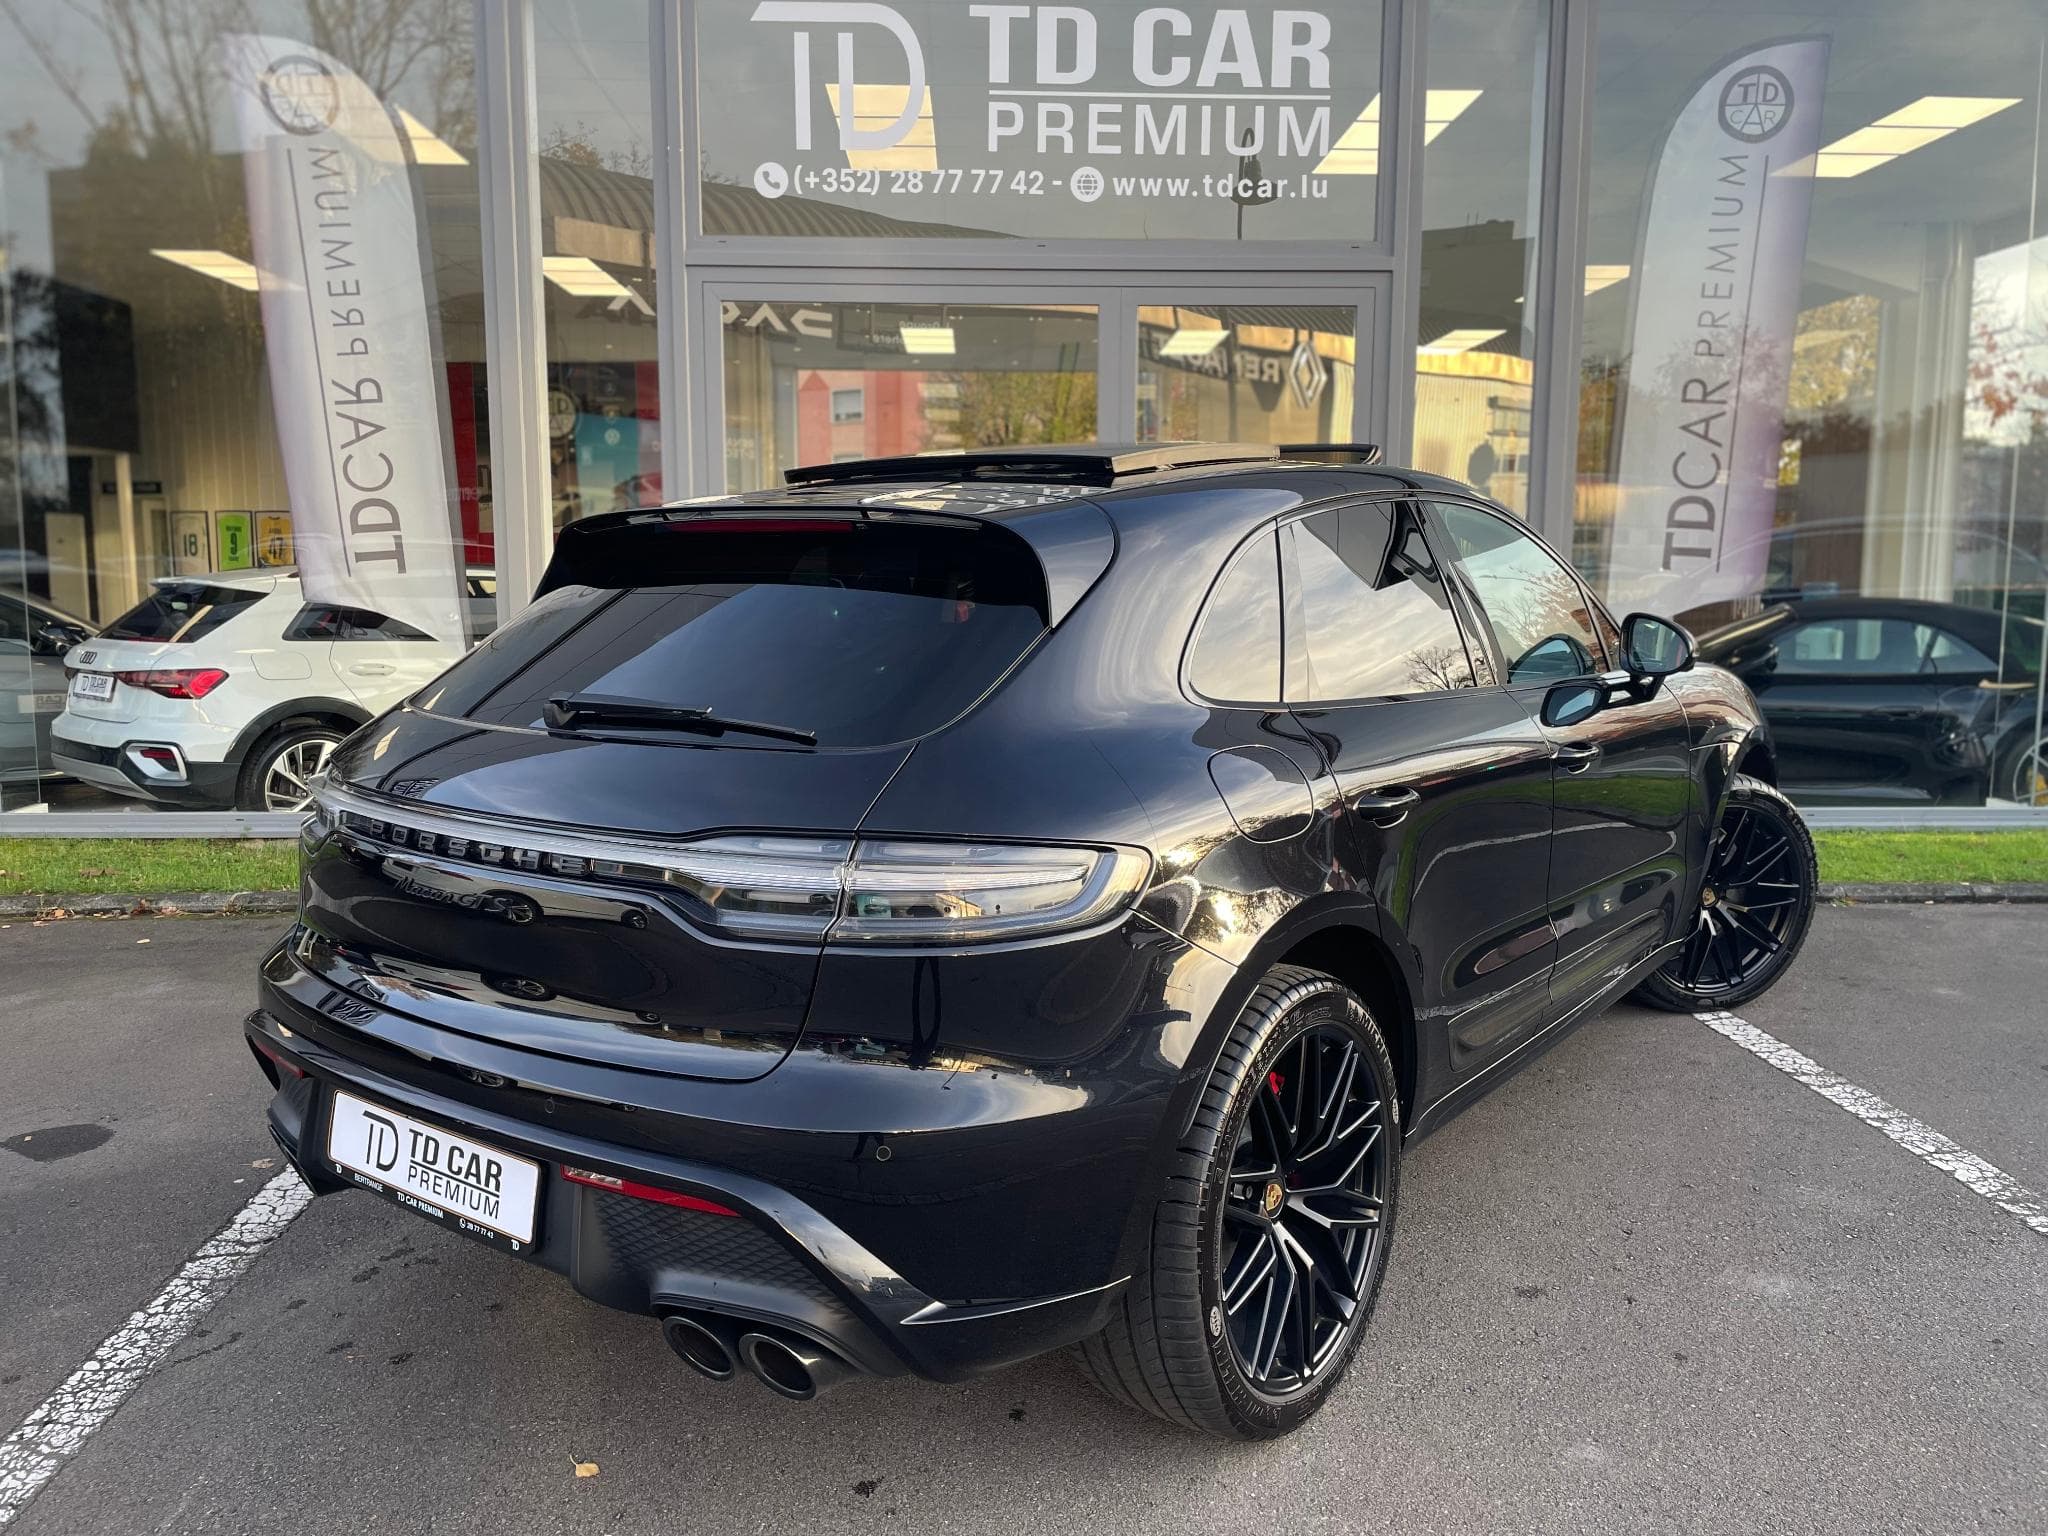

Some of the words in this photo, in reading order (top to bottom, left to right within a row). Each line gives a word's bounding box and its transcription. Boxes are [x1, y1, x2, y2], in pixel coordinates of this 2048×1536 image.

[969, 5, 1098, 84] TD
[1132, 7, 1331, 89] CAR
[988, 103, 1330, 156] PREMIUM
[794, 165, 880, 196] (+352)
[890, 169, 924, 194] 28
[930, 170, 963, 194] 77
[971, 169, 1004, 194] 77
[1010, 170, 1045, 196] 42
[1112, 173, 1328, 199] www.tdcar.lu
[1693, 155, 1749, 358] PREMIUM
[369, 818, 587, 876] PORSCHE
[408, 1128, 440, 1166] TD
[447, 1145, 503, 1192] CAR
[397, 1191, 405, 1202] TD
[405, 1195, 417, 1208] CAR
[407, 1164, 500, 1219] PREMIUM
